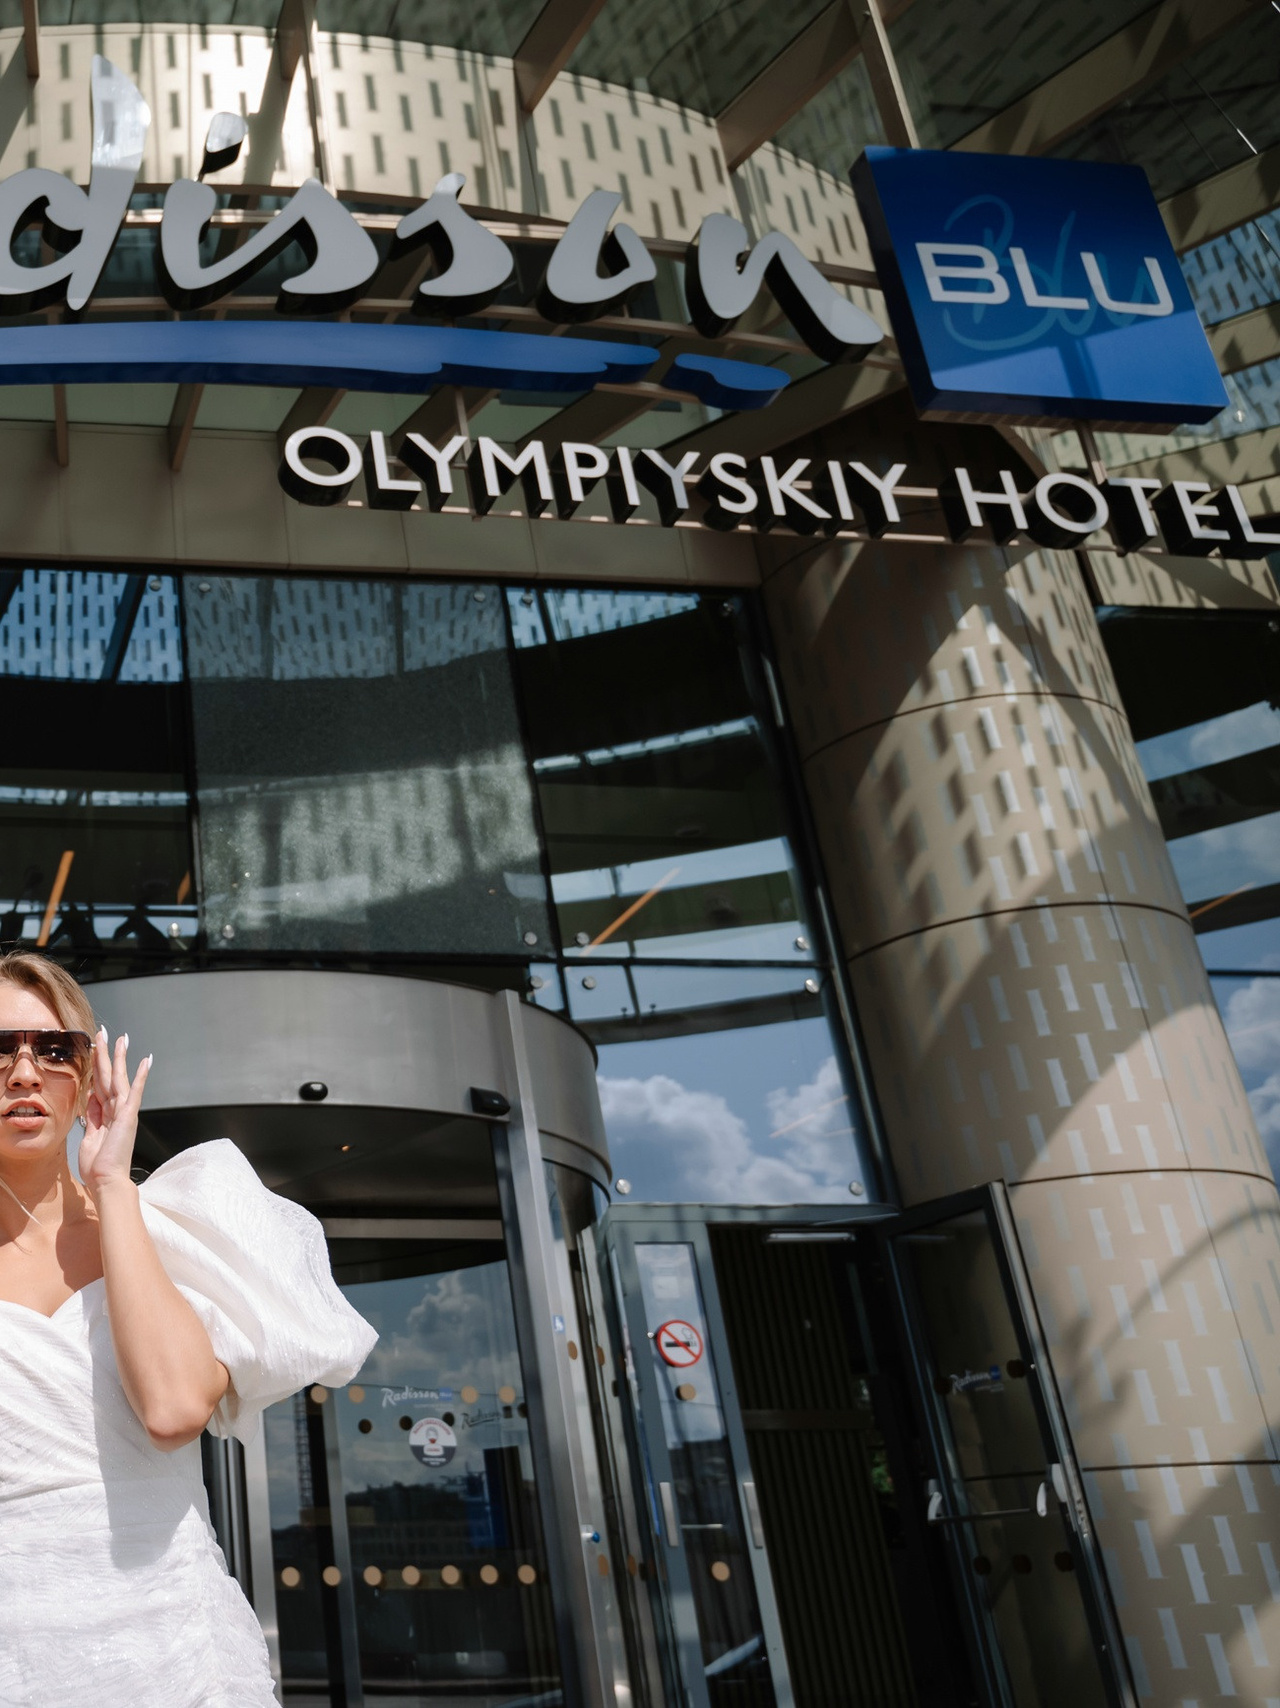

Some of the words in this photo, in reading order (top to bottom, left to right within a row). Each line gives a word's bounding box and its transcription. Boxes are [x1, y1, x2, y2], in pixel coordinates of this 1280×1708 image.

[915, 242, 1174, 317] BLU
[284, 426, 907, 523] OLYMPIYSKIY
[954, 472, 1280, 543] HOTEL
[380, 1385, 440, 1409] Radisson
